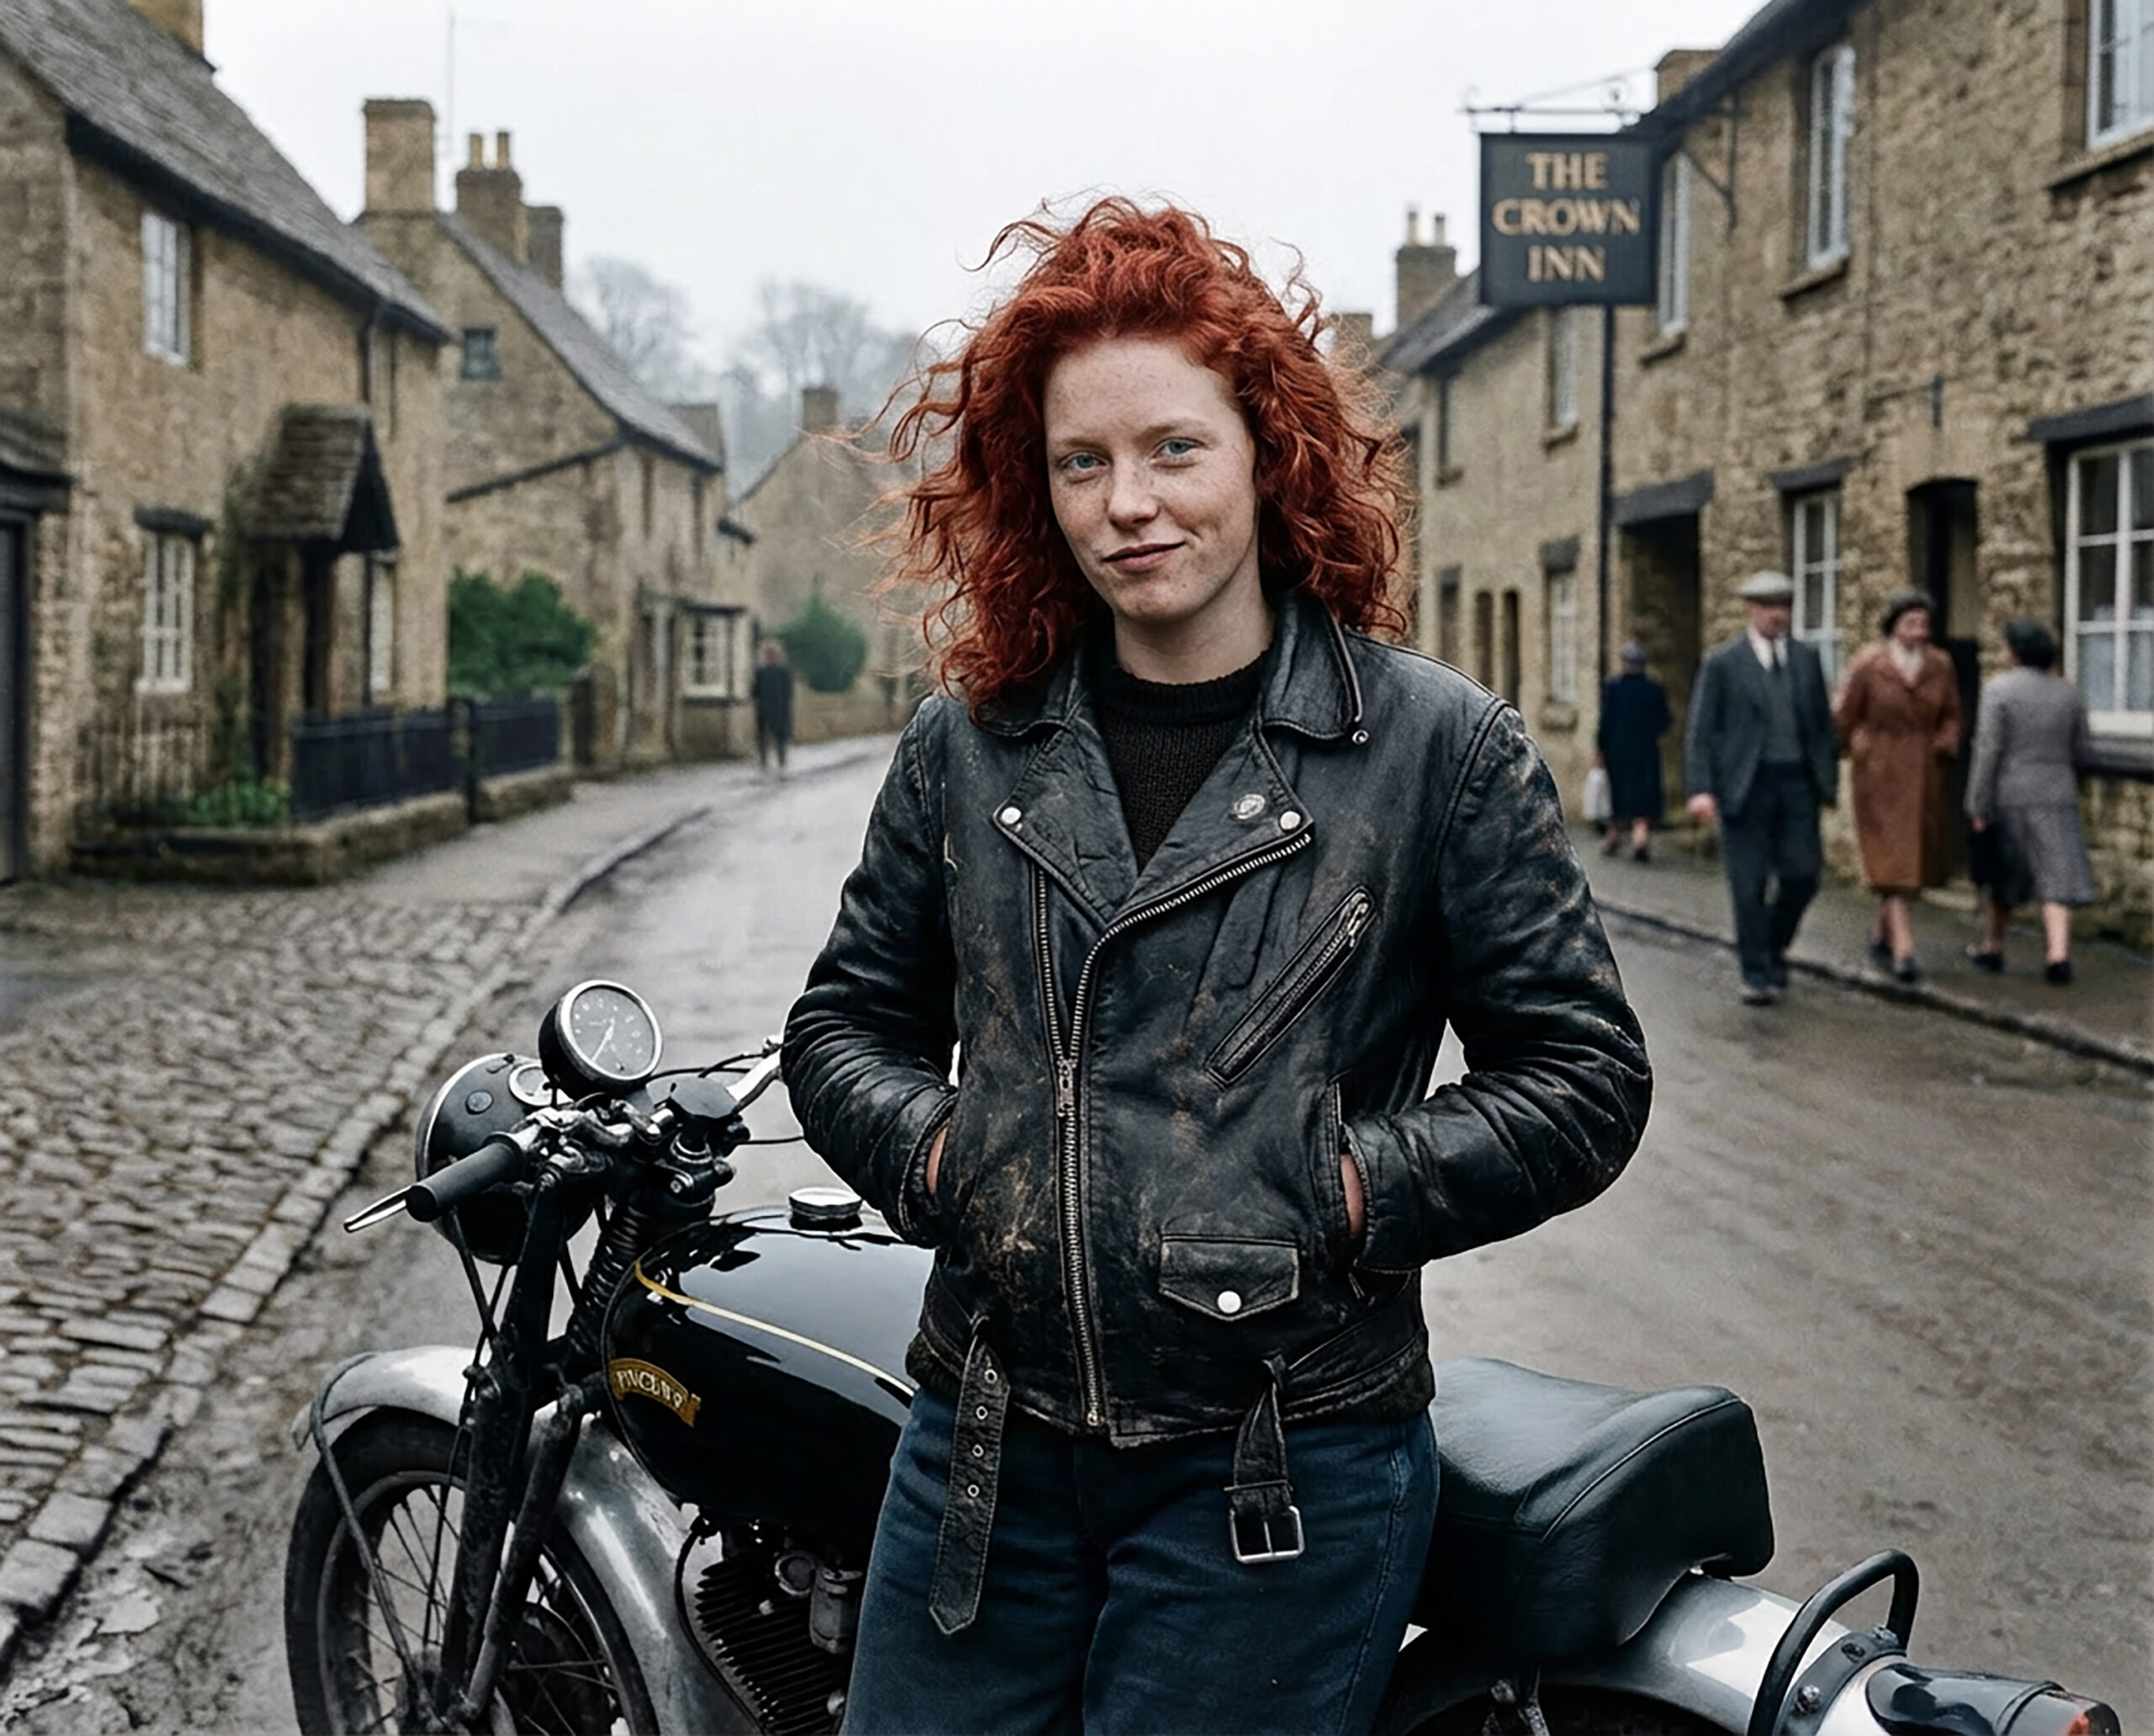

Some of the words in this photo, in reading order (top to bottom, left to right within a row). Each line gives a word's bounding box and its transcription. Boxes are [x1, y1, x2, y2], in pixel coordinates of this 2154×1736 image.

[1525, 152, 1608, 189] THE
[1492, 198, 1641, 236] CROWN
[1527, 245, 1605, 282] INN
